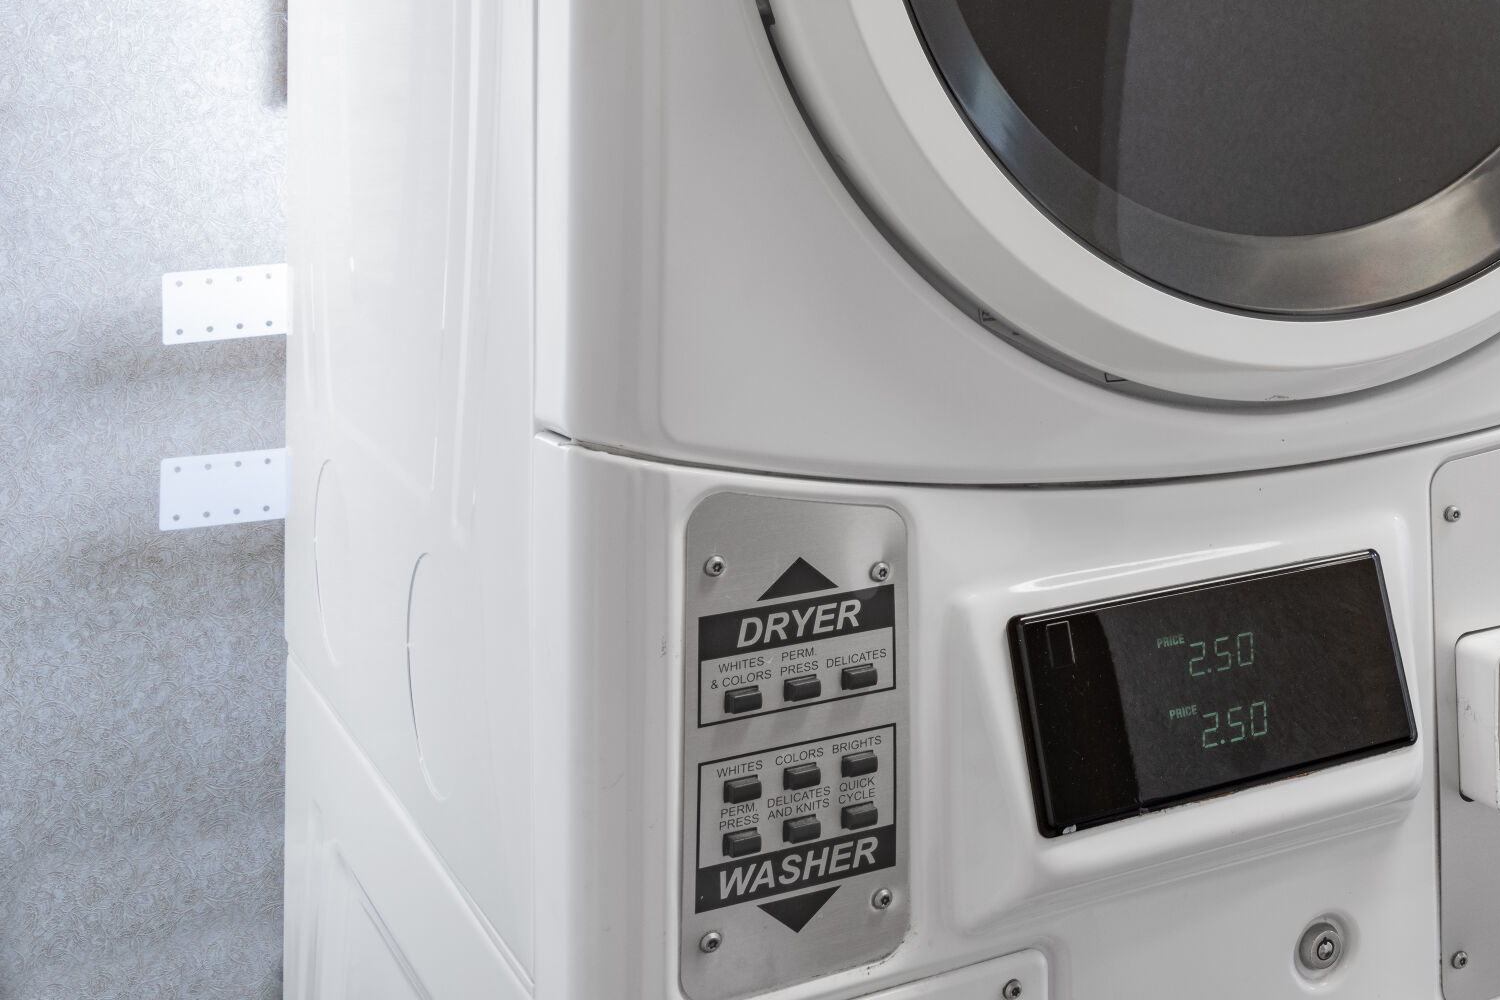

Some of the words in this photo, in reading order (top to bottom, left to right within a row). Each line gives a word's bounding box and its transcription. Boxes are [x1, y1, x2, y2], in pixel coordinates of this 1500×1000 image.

[736, 599, 862, 648] DRYER
[781, 647, 817, 661] PERM.
[826, 648, 887, 669] DELICATES
[1156, 633, 1185, 649] PRICE
[1189, 631, 1254, 677] 2.50
[718, 656, 765, 674] WHITES
[780, 660, 819, 676] PRESS
[710, 679, 719, 690] &
[722, 669, 772, 687] COLORS
[1169, 704, 1197, 720] PRICE
[1202, 700, 1268, 748] 2.50
[832, 735, 882, 754] BRIGHTS
[775, 747, 824, 766] COLORS
[716, 760, 763, 778] WHITES
[839, 776, 876, 793] QUICK
[767, 786, 831, 809] DELICATES
[838, 787, 876, 805] CYCLE
[720, 802, 758, 819] PERM.
[767, 806, 793, 821] AND
[796, 798, 830, 815] KNITS
[719, 814, 760, 831] PRESS
[719, 836, 879, 900] WASHER
